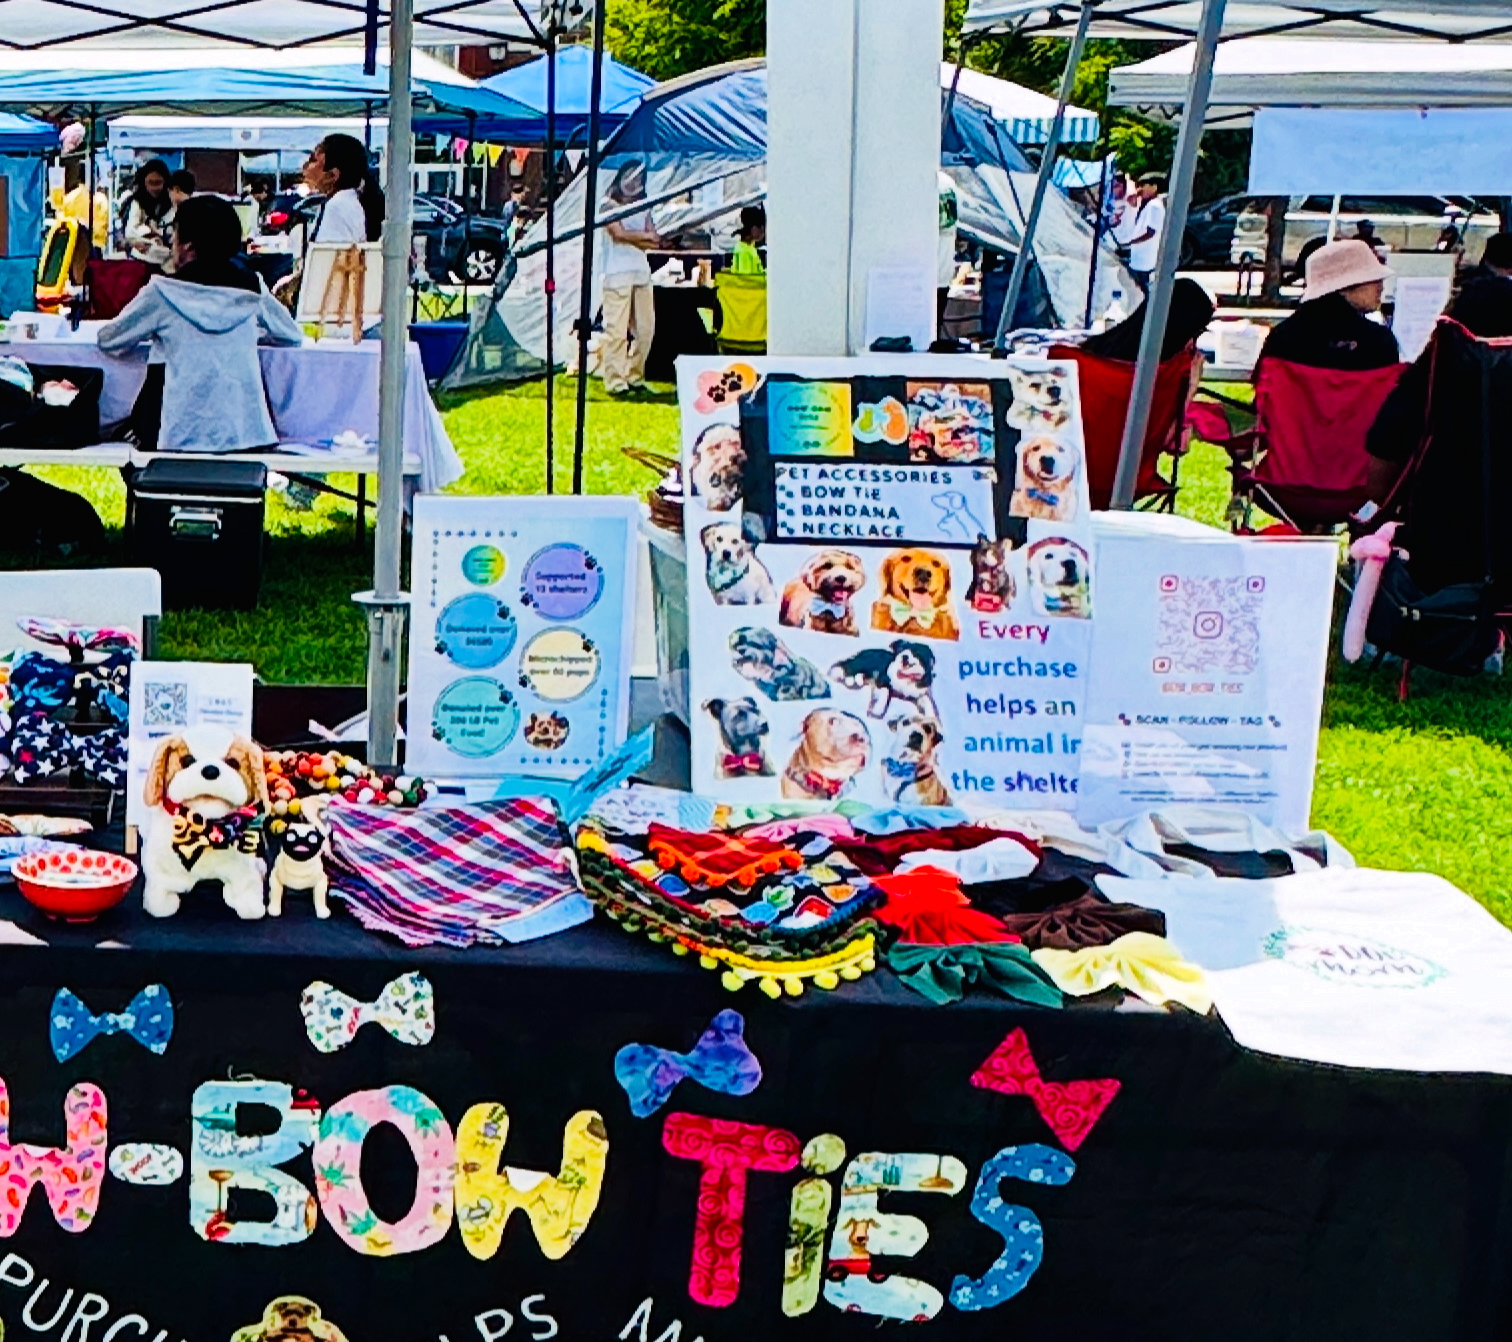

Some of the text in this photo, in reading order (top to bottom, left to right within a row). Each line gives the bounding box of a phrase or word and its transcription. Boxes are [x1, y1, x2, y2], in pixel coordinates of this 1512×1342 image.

[800, 485, 846, 500] BOW
[800, 503, 901, 521] BANDANA
[801, 522, 906, 539] NECKLACE
[978, 620, 1051, 645] Every
[958, 656, 1078, 681] purchase
[966, 693, 1077, 720] helps an
[964, 731, 1054, 755] animal
[951, 769, 1080, 794] the shelte
